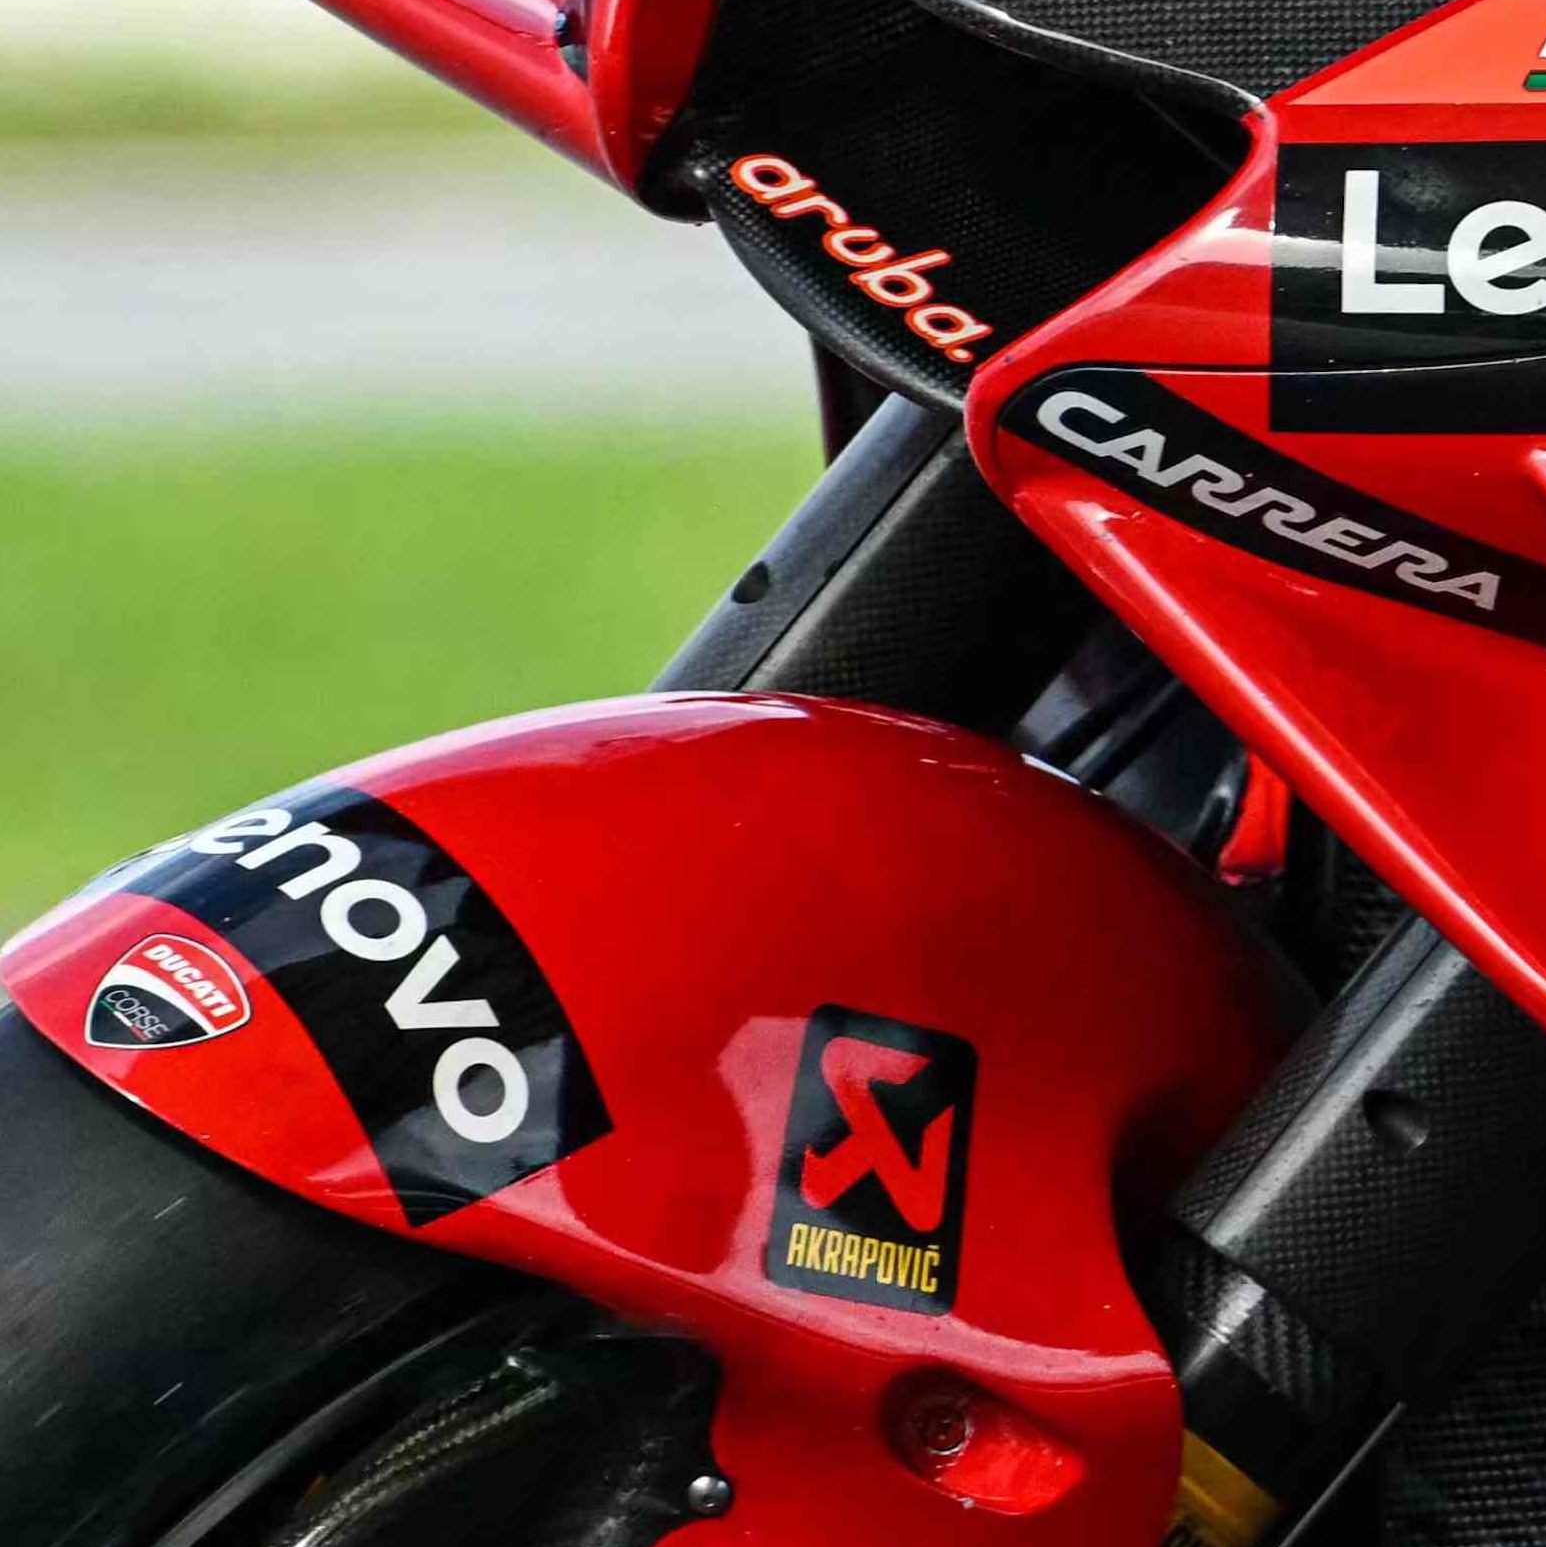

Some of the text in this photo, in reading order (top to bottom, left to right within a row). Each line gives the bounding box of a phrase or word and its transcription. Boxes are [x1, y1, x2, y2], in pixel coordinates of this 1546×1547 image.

[1036, 388, 1504, 613] CARRERA
[104, 989, 171, 1040] CORSE
[141, 944, 238, 1018] DUCATI
[786, 1222, 943, 1295] AKRAPOVIČ
